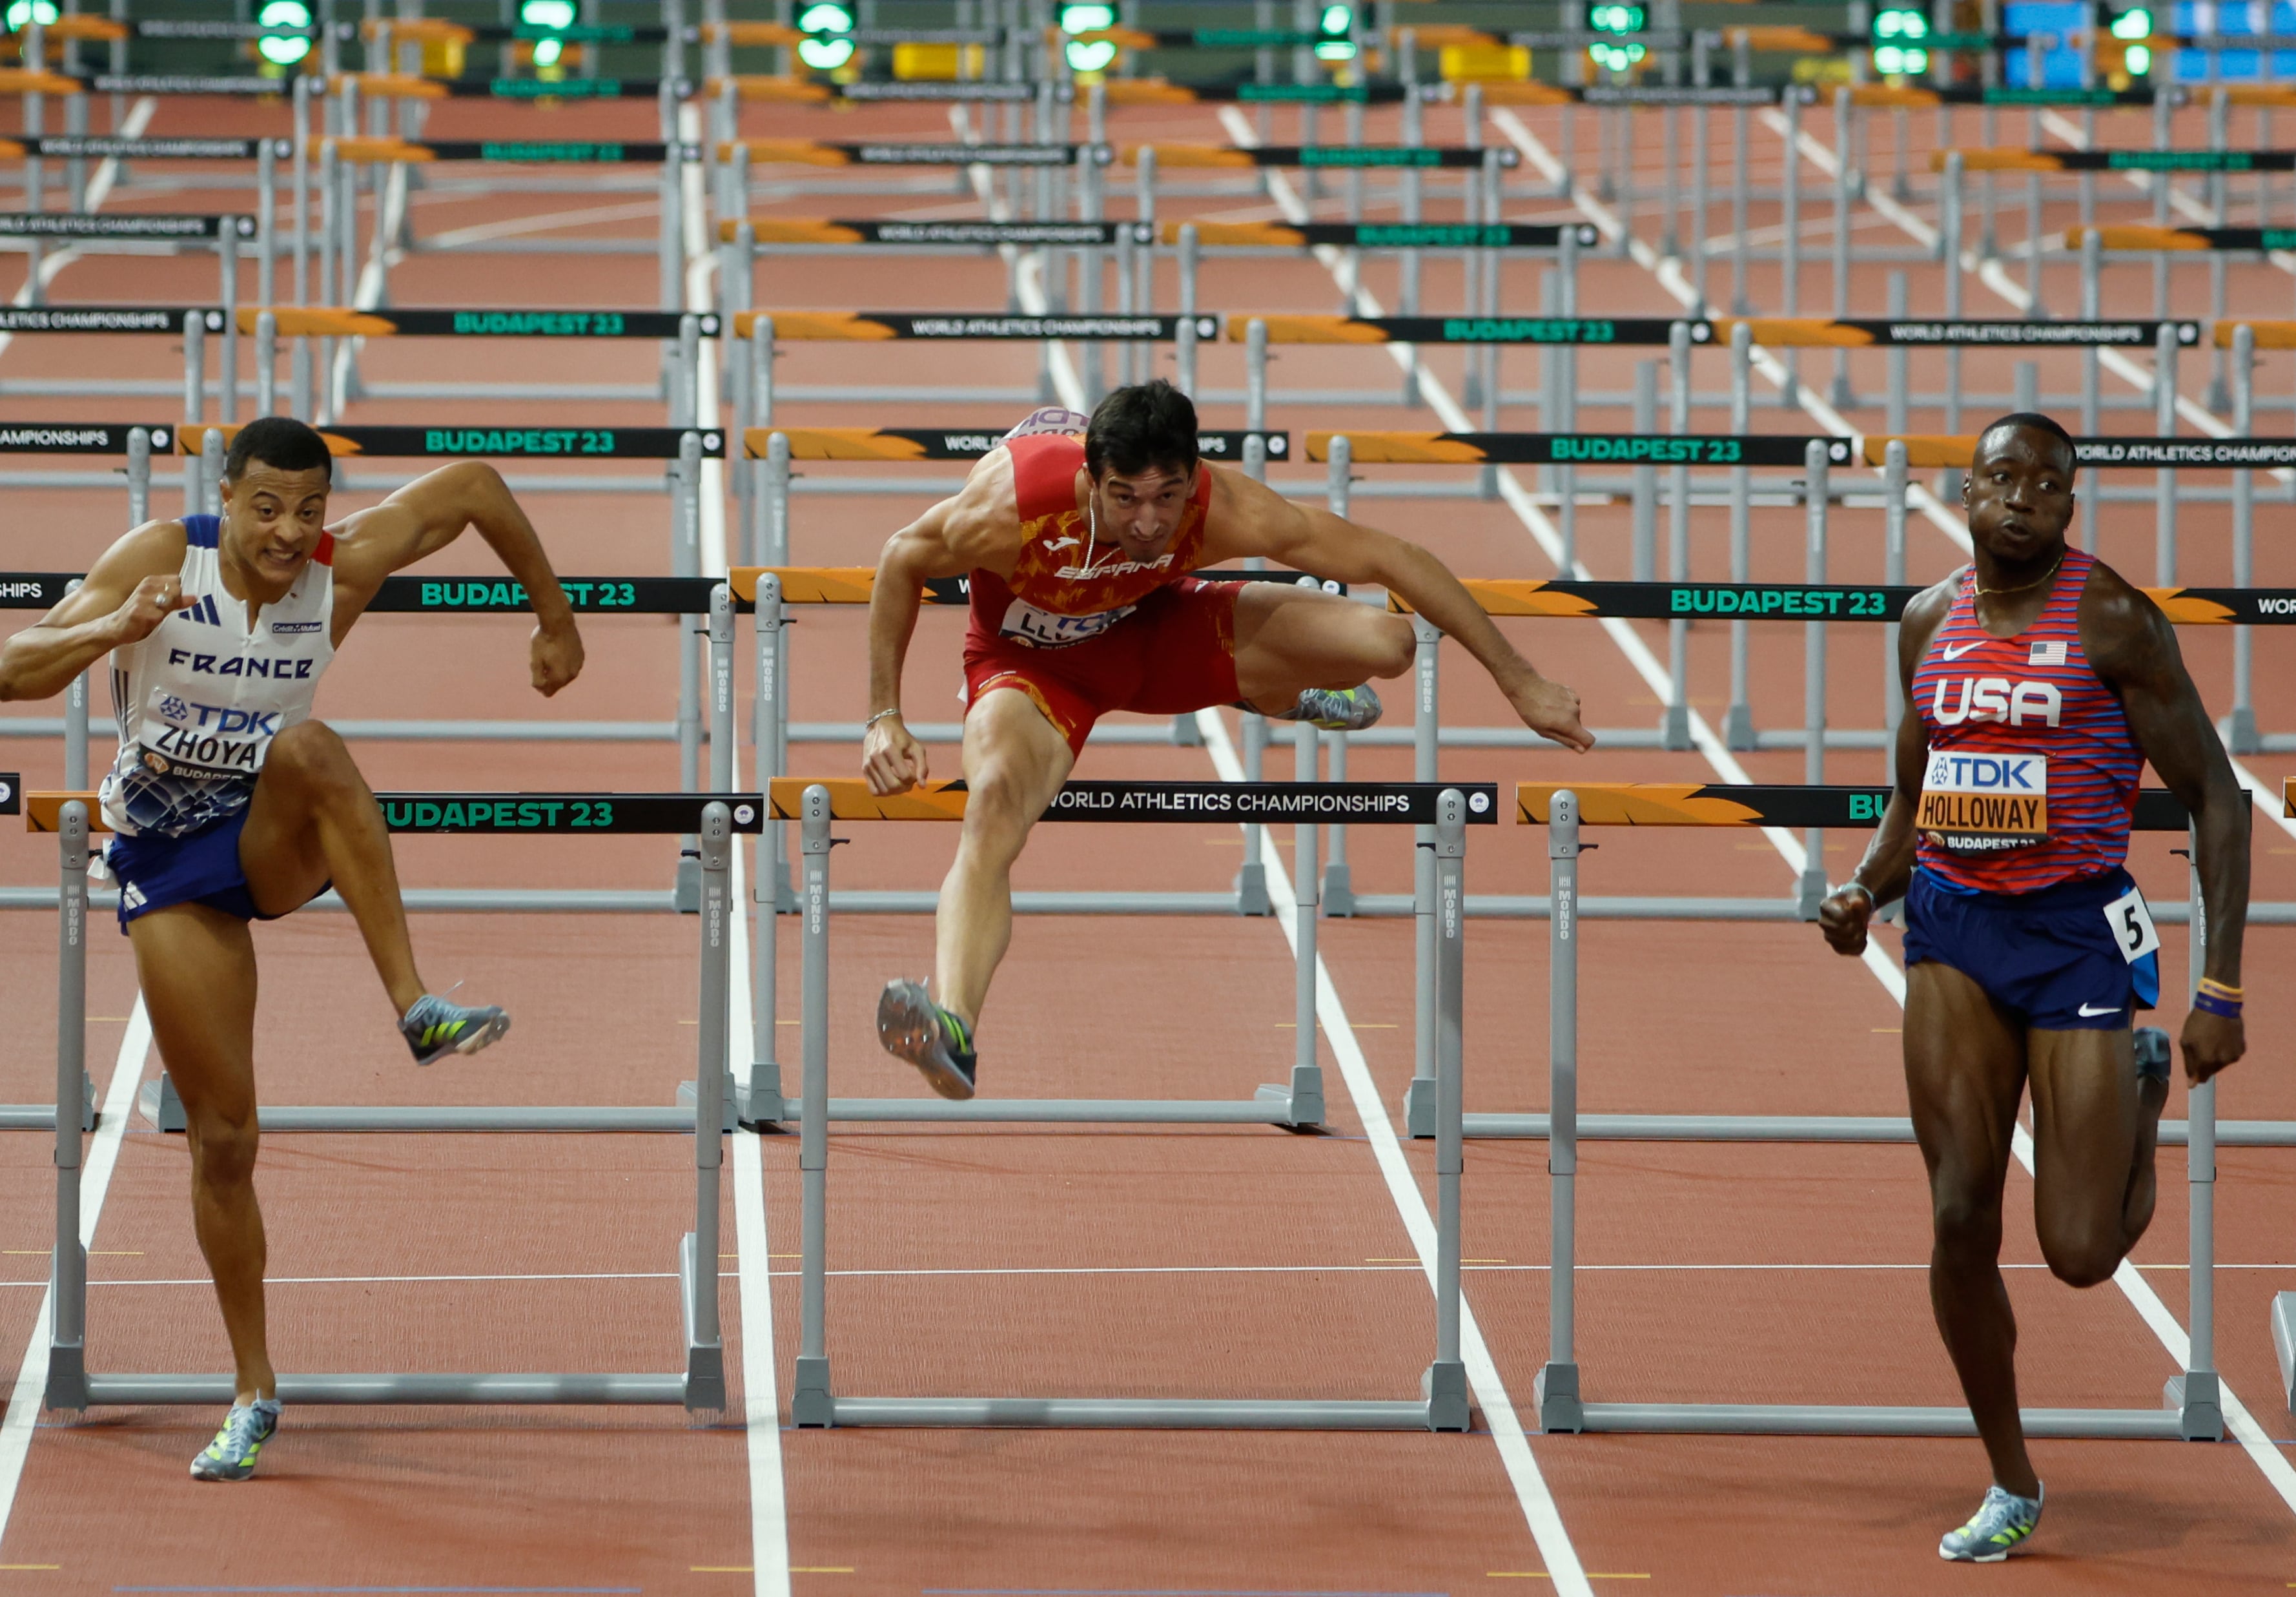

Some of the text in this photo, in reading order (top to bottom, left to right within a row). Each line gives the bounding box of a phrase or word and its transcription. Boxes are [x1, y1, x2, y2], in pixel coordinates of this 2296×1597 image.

[51, 311, 169, 329] CHAMPIONSHIPS
[454, 313, 624, 335] BUDAPEST 23
[912, 319, 1162, 336] WORLD ATHLETICS CHAMPIONSHIPS
[1444, 319, 1614, 342] BUDAPEST 23
[1890, 324, 2142, 342] WORLD ATHLETICS CHAMPIONSHIPS
[425, 430, 614, 452] BUDAPEST 23
[1551, 438, 1741, 461] BUDAPEST 23
[2127, 445, 2213, 462] ATHLETICS
[422, 583, 636, 606] BUDAPST 23
[1671, 589, 1886, 615] BUDAPEST 23
[169, 648, 313, 679] FRANCE
[717, 670, 728, 712] MONDO
[763, 658, 774, 701] MONDO
[1422, 670, 1433, 713] MONDO
[1932, 677, 2062, 727] USA
[190, 702, 280, 736] TDK
[156, 722, 256, 769] ZHOYA
[1950, 757, 2033, 789] TDK
[378, 803, 613, 827] UDAPEST 23
[1120, 792, 1231, 810] ATHLETICS
[1236, 794, 1409, 812] CHAMPIONSHIPS
[1922, 795, 2038, 830] HOLLOWAY
[1947, 836, 2018, 850] BUDAPEST
[67, 898, 79, 945] MONDO
[709, 900, 721, 947] MONDO
[810, 885, 823, 934] MONDO
[1444, 889, 1457, 938] MONDO
[1559, 890, 1571, 940] MONDO
[2123, 905, 2144, 951] 5
